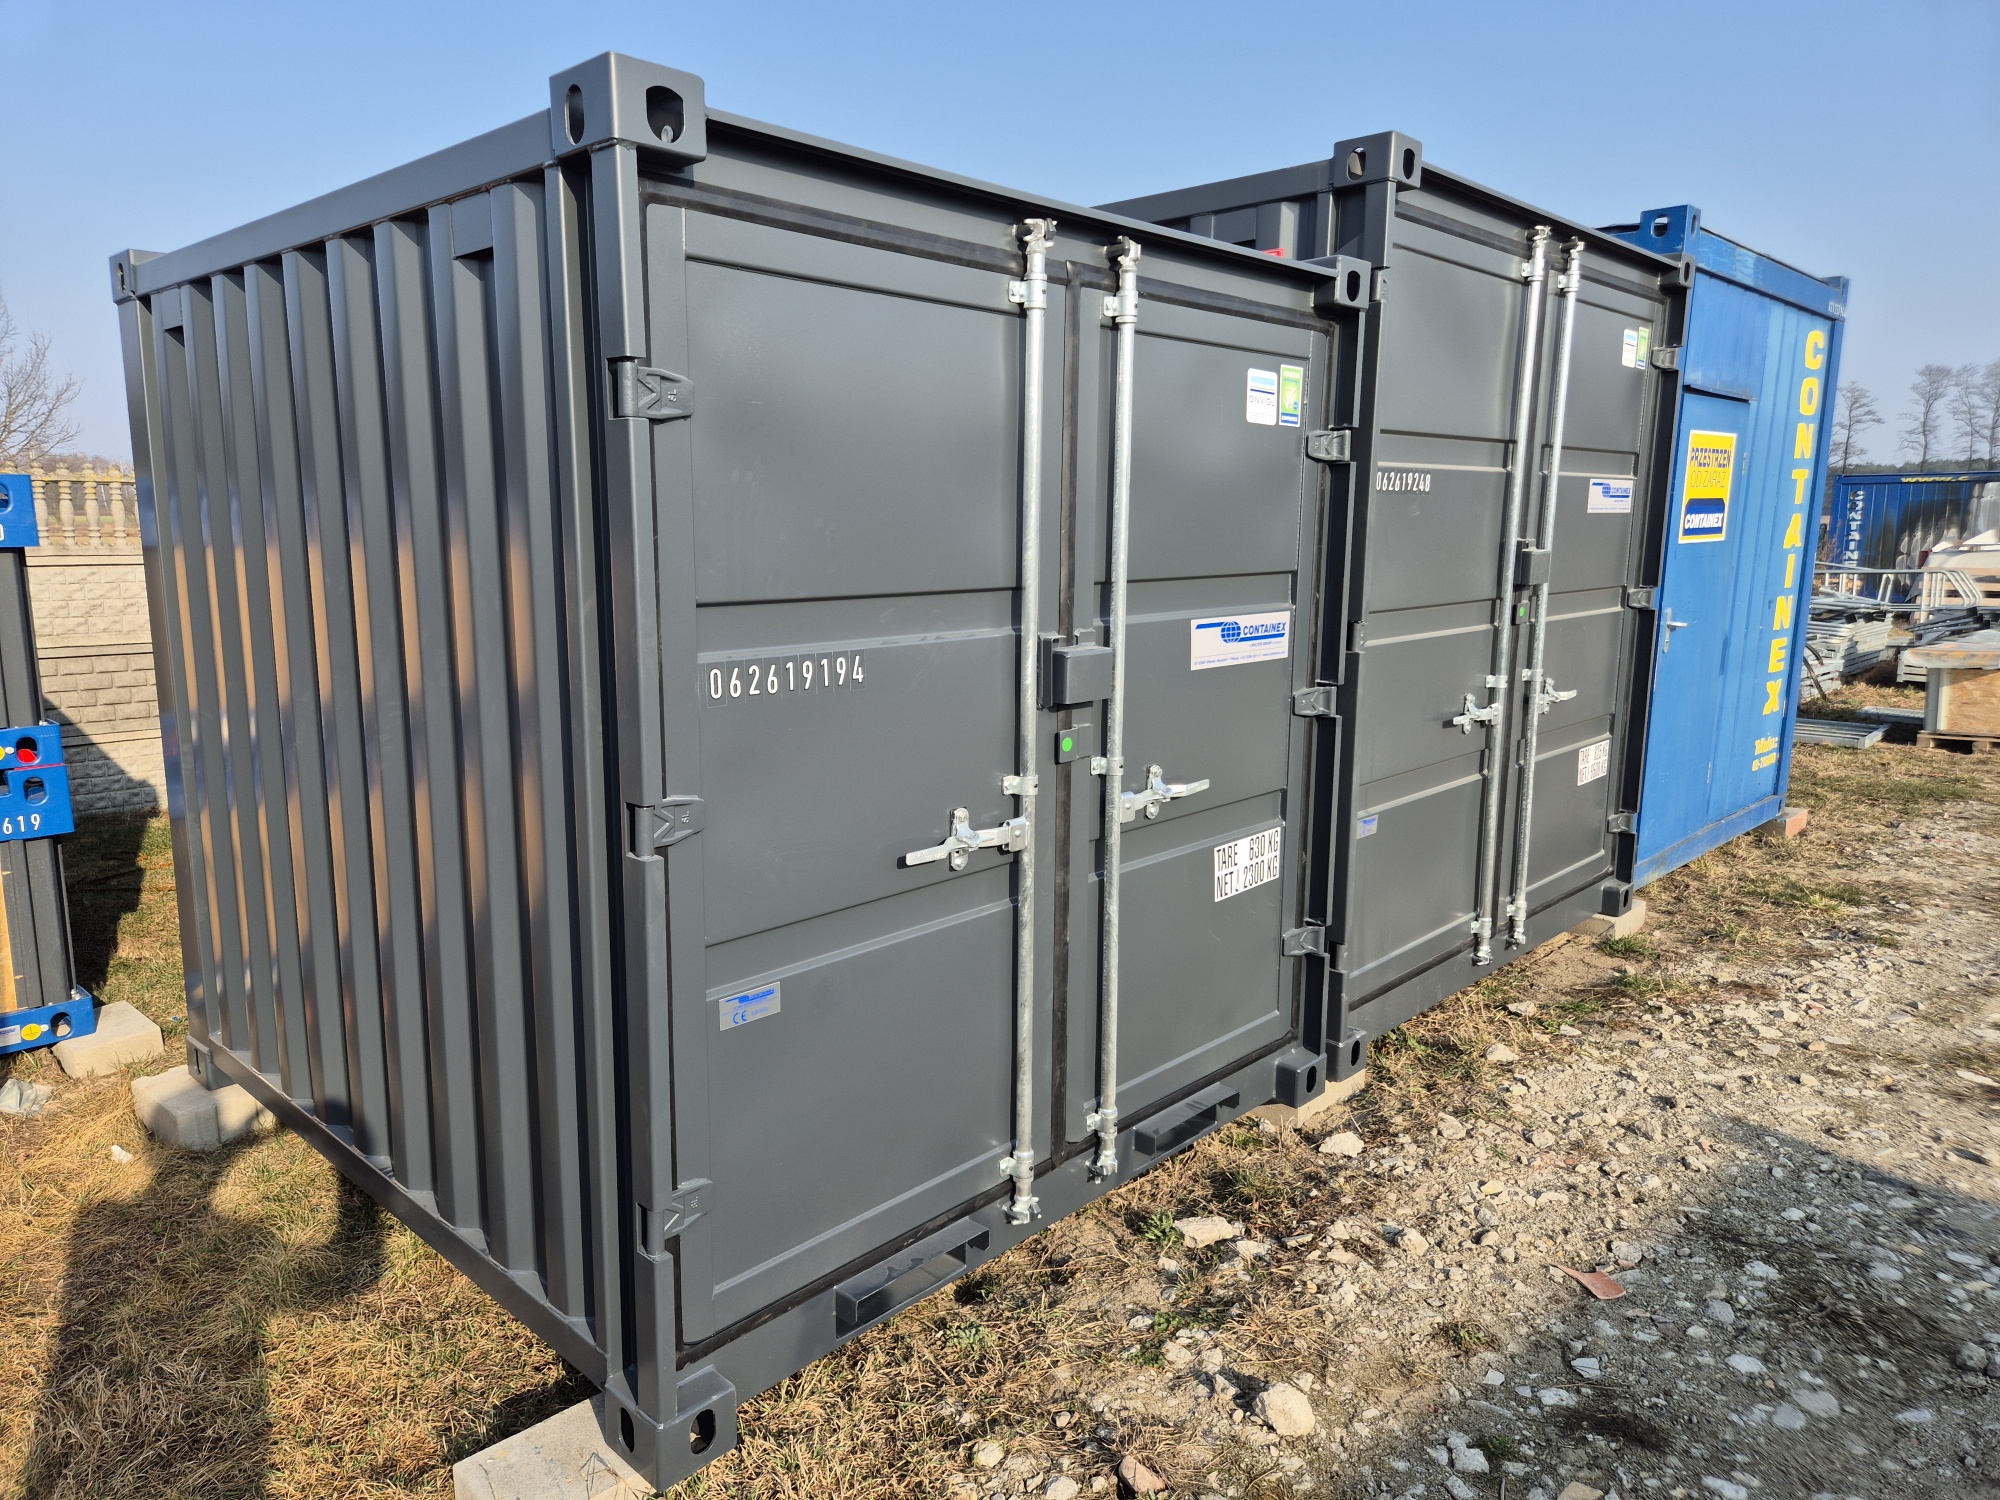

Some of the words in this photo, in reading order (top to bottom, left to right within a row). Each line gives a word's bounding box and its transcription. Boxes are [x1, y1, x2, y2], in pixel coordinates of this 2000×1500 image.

[1249, 395, 1264, 404] DNV
[1266, 398, 1275, 406] GL
[1690, 444, 1732, 468] PRZESTRZEŃ
[1376, 471, 1431, 492] 062619248
[1703, 470, 1726, 488] ZARAZ
[1684, 512, 1724, 529] CONTAINEX
[1763, 330, 1824, 715] CONTAINEX
[1843, 490, 1864, 567] CONTAINE
[1243, 622, 1286, 636] CONTAINEX
[709, 655, 864, 699] 062619194
[2, 813, 41, 835] 619
[1216, 843, 1238, 872] TARE
[1249, 834, 1265, 861] 630
[1268, 830, 1279, 854] KG
[1217, 871, 1233, 899] NET
[1243, 860, 1264, 888] 2300
[1267, 855, 1278, 879] KG
